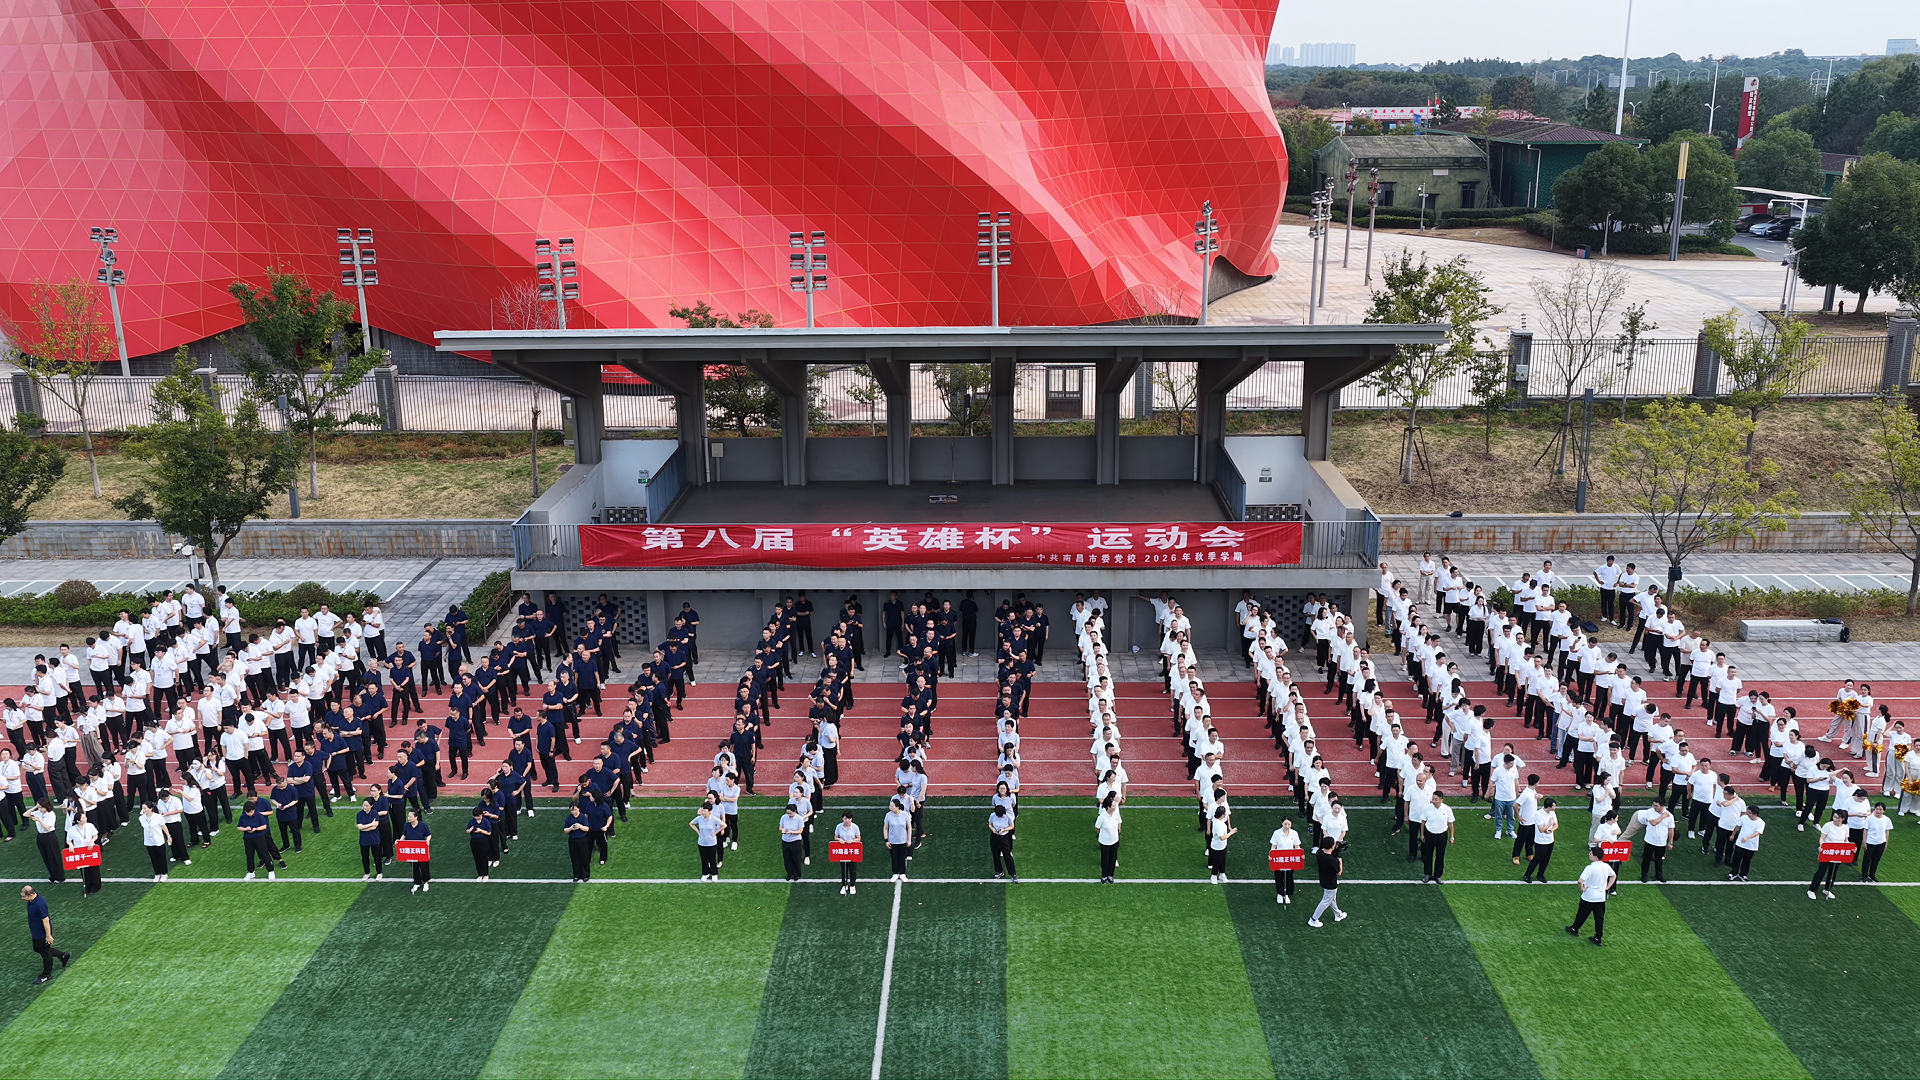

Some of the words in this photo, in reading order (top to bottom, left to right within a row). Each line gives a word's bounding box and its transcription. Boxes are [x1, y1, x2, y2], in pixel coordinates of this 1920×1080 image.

[641, 527, 795, 551] 第八届
[1087, 525, 1246, 550] 运动会
